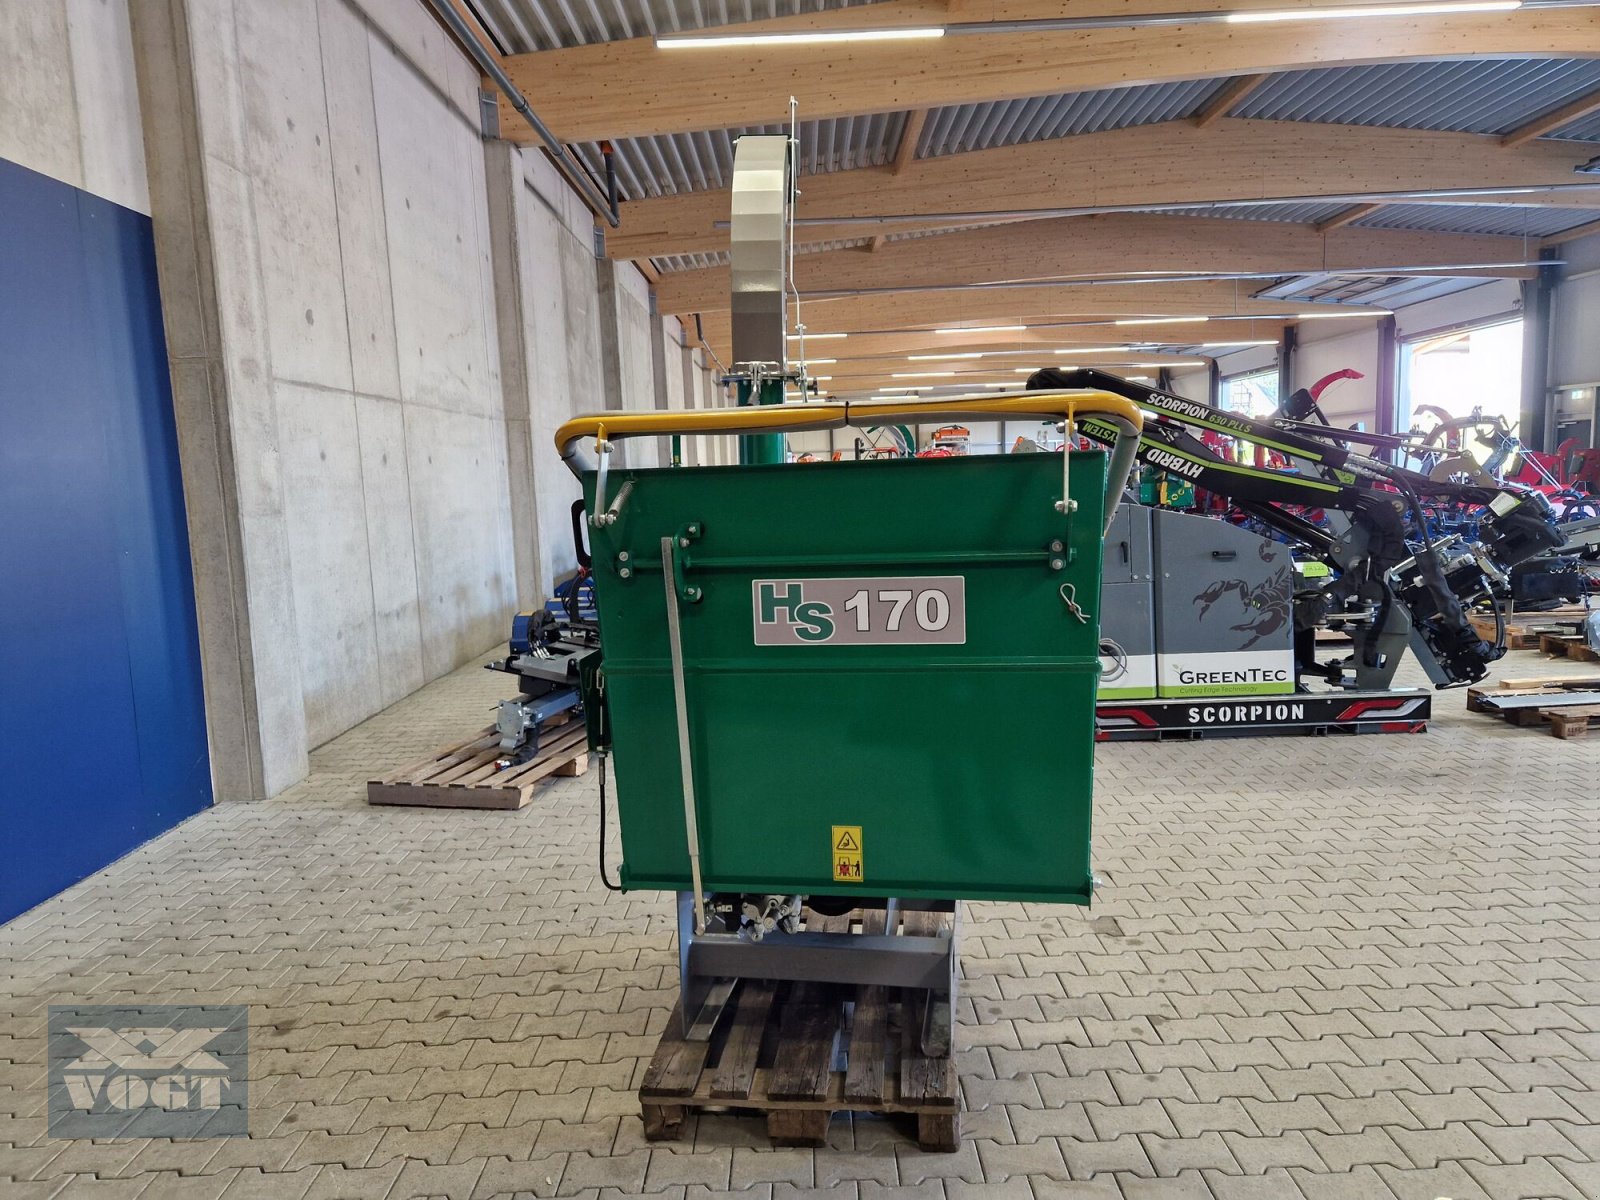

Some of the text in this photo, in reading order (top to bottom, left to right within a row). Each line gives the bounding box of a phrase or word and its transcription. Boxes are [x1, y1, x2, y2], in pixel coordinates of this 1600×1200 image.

[1146, 393, 1210, 420] SCORPION
[1208, 414, 1228, 426] 630
[1082, 422, 1205, 479] HYBRID YSTEM
[758, 582, 950, 642] HS 170
[1221, 685, 1258, 693] Technology
[1188, 703, 1304, 723] SCORPION
